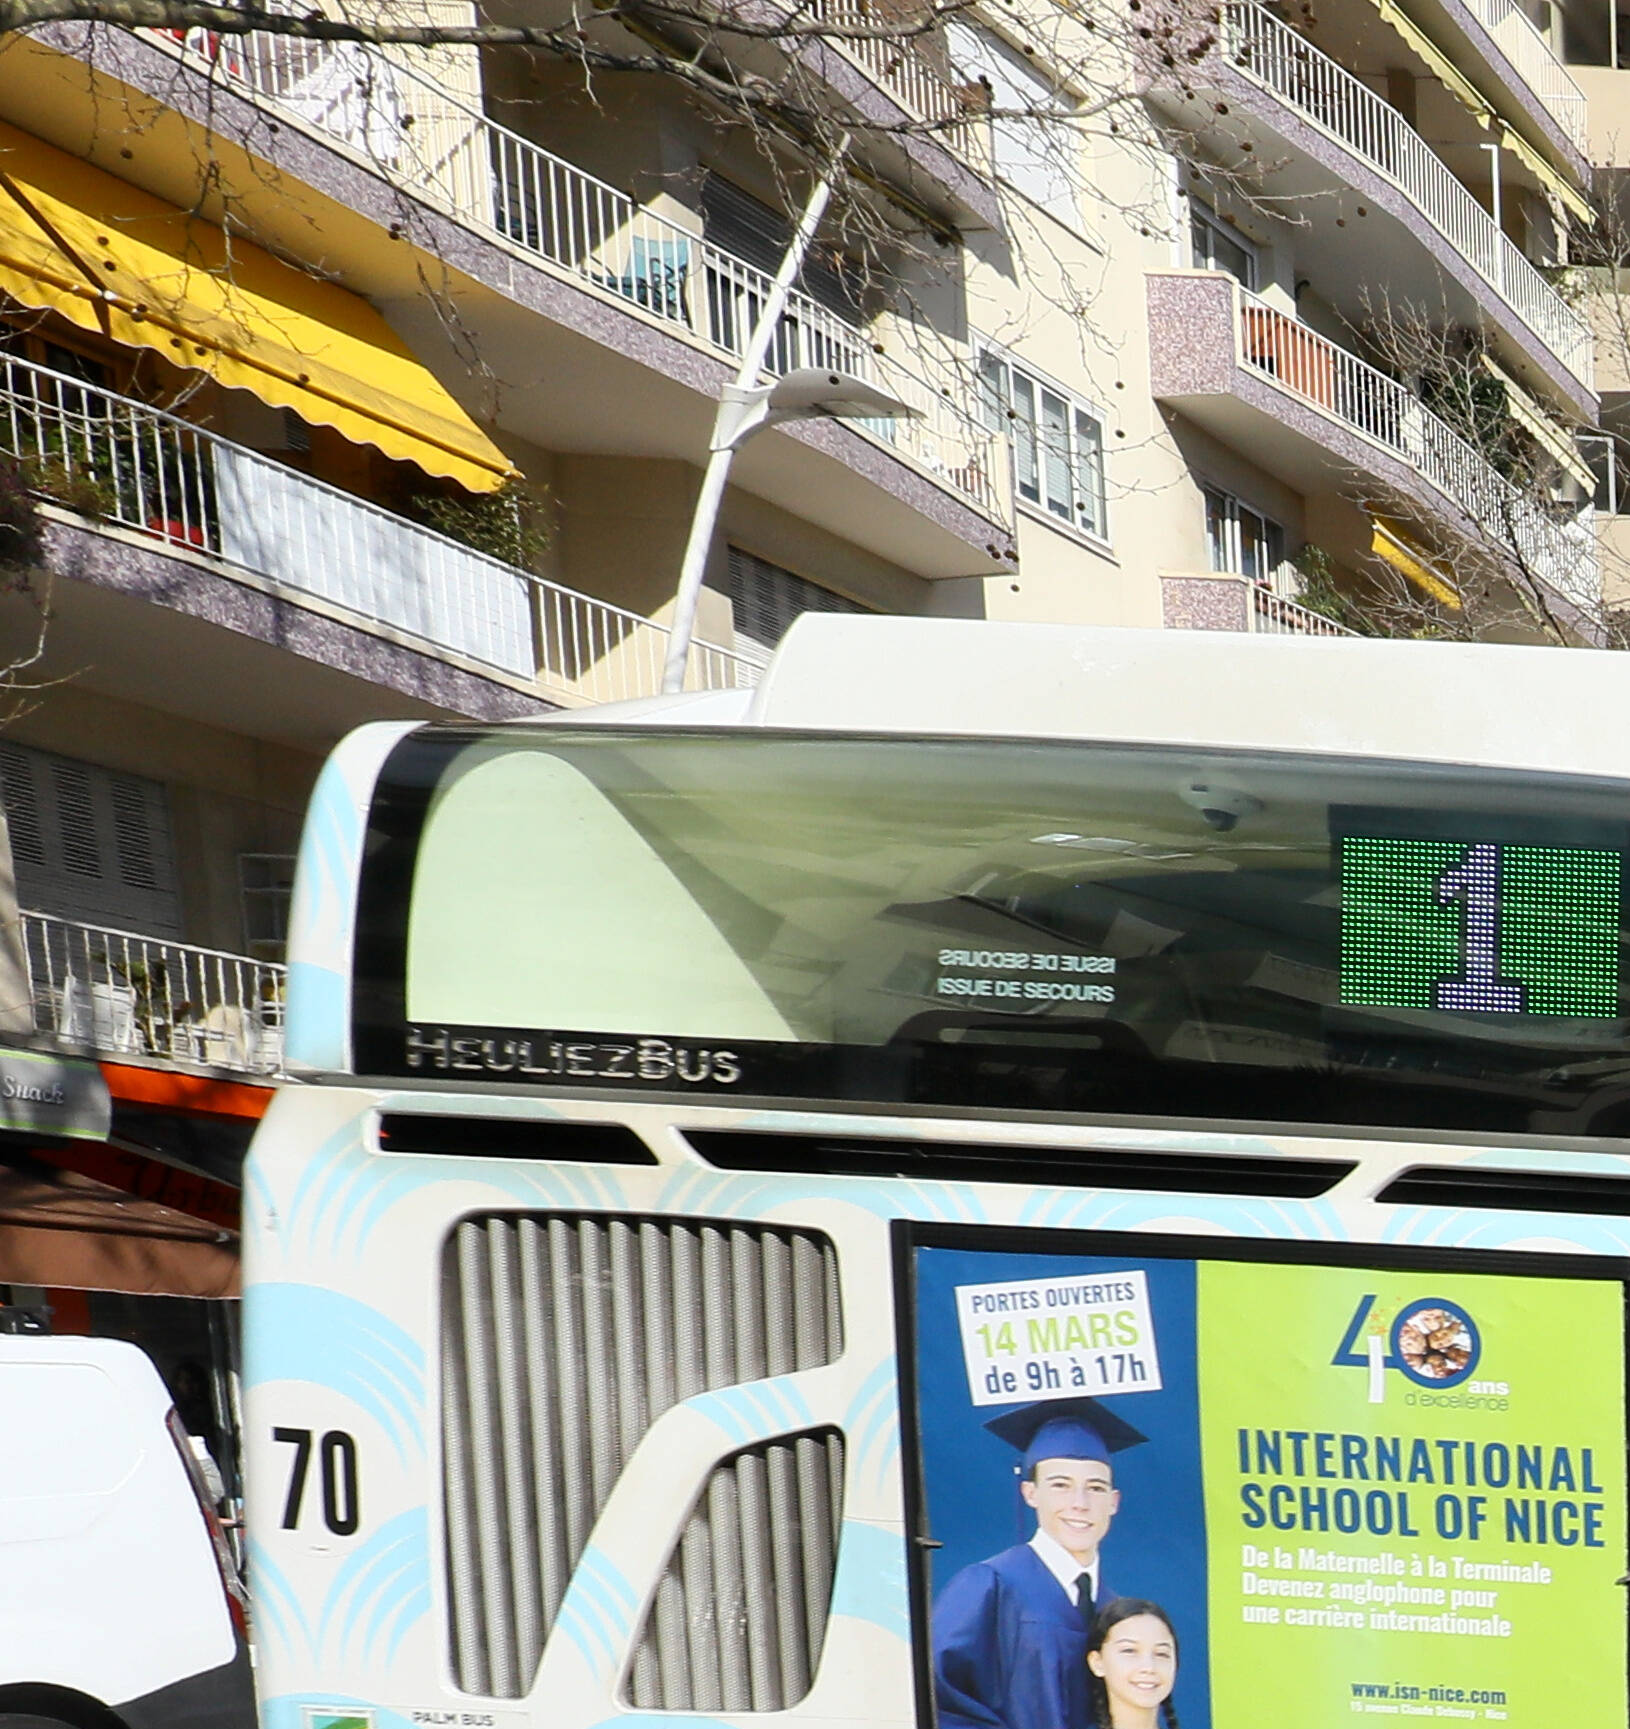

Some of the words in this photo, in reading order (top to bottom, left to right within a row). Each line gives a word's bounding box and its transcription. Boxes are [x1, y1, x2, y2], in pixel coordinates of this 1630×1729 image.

[1437, 843, 1521, 1013] 1
[937, 977, 993, 997] ISSUE
[994, 980, 1022, 998] DE
[1023, 982, 1116, 1003] SECOURS
[2, 1075, 65, 1105] Snack
[971, 1290, 1040, 1313] PORTES
[1045, 1282, 1136, 1307] OUVERTES
[975, 1321, 1018, 1358] 14
[1025, 1309, 1140, 1354] MARS
[1330, 1294, 1482, 1404] 40
[1467, 1380, 1510, 1396] ans
[985, 1364, 1017, 1394] de
[1026, 1360, 1061, 1391] 9h
[1069, 1357, 1086, 1387] à
[1095, 1353, 1147, 1385] 17h
[1404, 1391, 1510, 1412] d'excellence
[1237, 1428, 1604, 1494] INTERNATIONAL
[271, 1426, 360, 1537] 70
[1240, 1482, 1420, 1537] SCHOOL
[1435, 1493, 1488, 1541] OF
[1505, 1497, 1605, 1548] NICE
[1242, 1543, 1270, 1568] De
[1274, 1546, 1293, 1570] la
[1298, 1547, 1406, 1577] Maternelle
[1410, 1552, 1424, 1578] à
[1428, 1554, 1447, 1579] la
[1450, 1556, 1553, 1585] Terminale
[1242, 1571, 1325, 1599] Devenez
[1328, 1577, 1447, 1608] anglophone
[1450, 1587, 1499, 1611] pour
[1242, 1605, 1280, 1625] une
[1284, 1603, 1365, 1630] carrière
[1369, 1607, 1513, 1638] internationale
[1350, 1681, 1507, 1705] www.isn-nice.com
[412, 1711, 457, 1725] PALM
[462, 1713, 495, 1727] BUS
